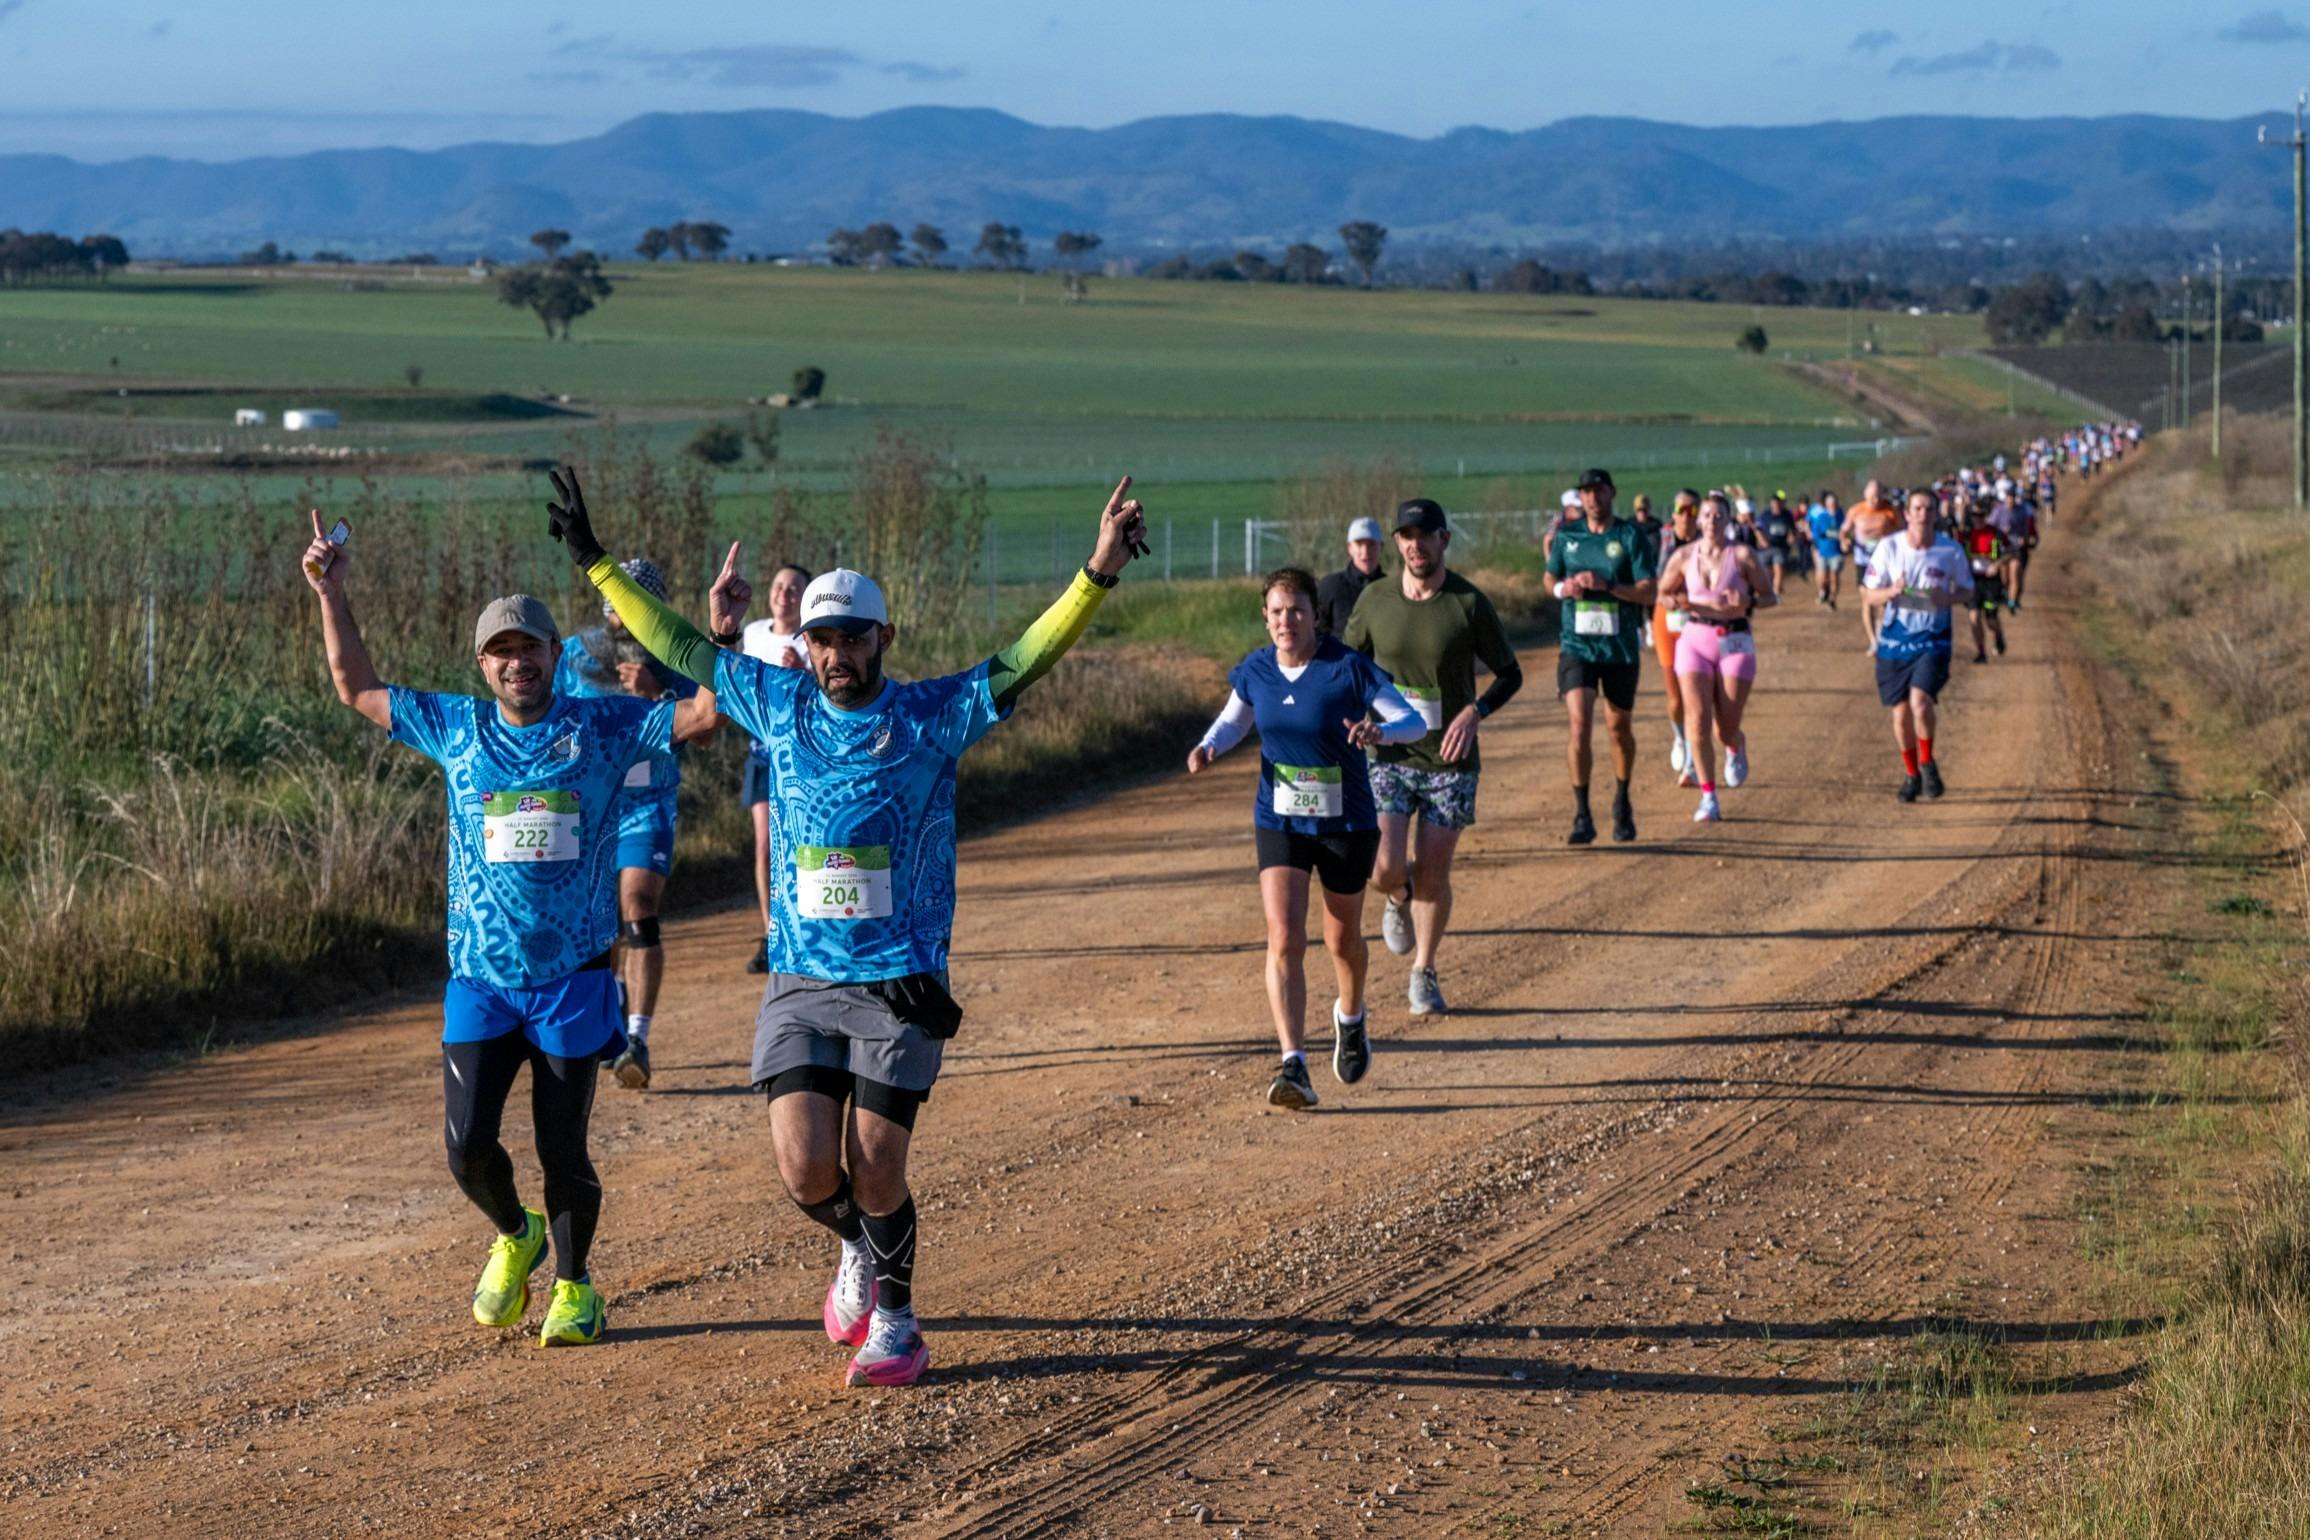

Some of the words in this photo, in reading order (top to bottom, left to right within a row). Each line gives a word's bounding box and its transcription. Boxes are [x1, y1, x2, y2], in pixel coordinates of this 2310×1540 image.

[1294, 794, 1319, 807] 284
[515, 830, 548, 847] 222
[823, 887, 859, 904] 204
